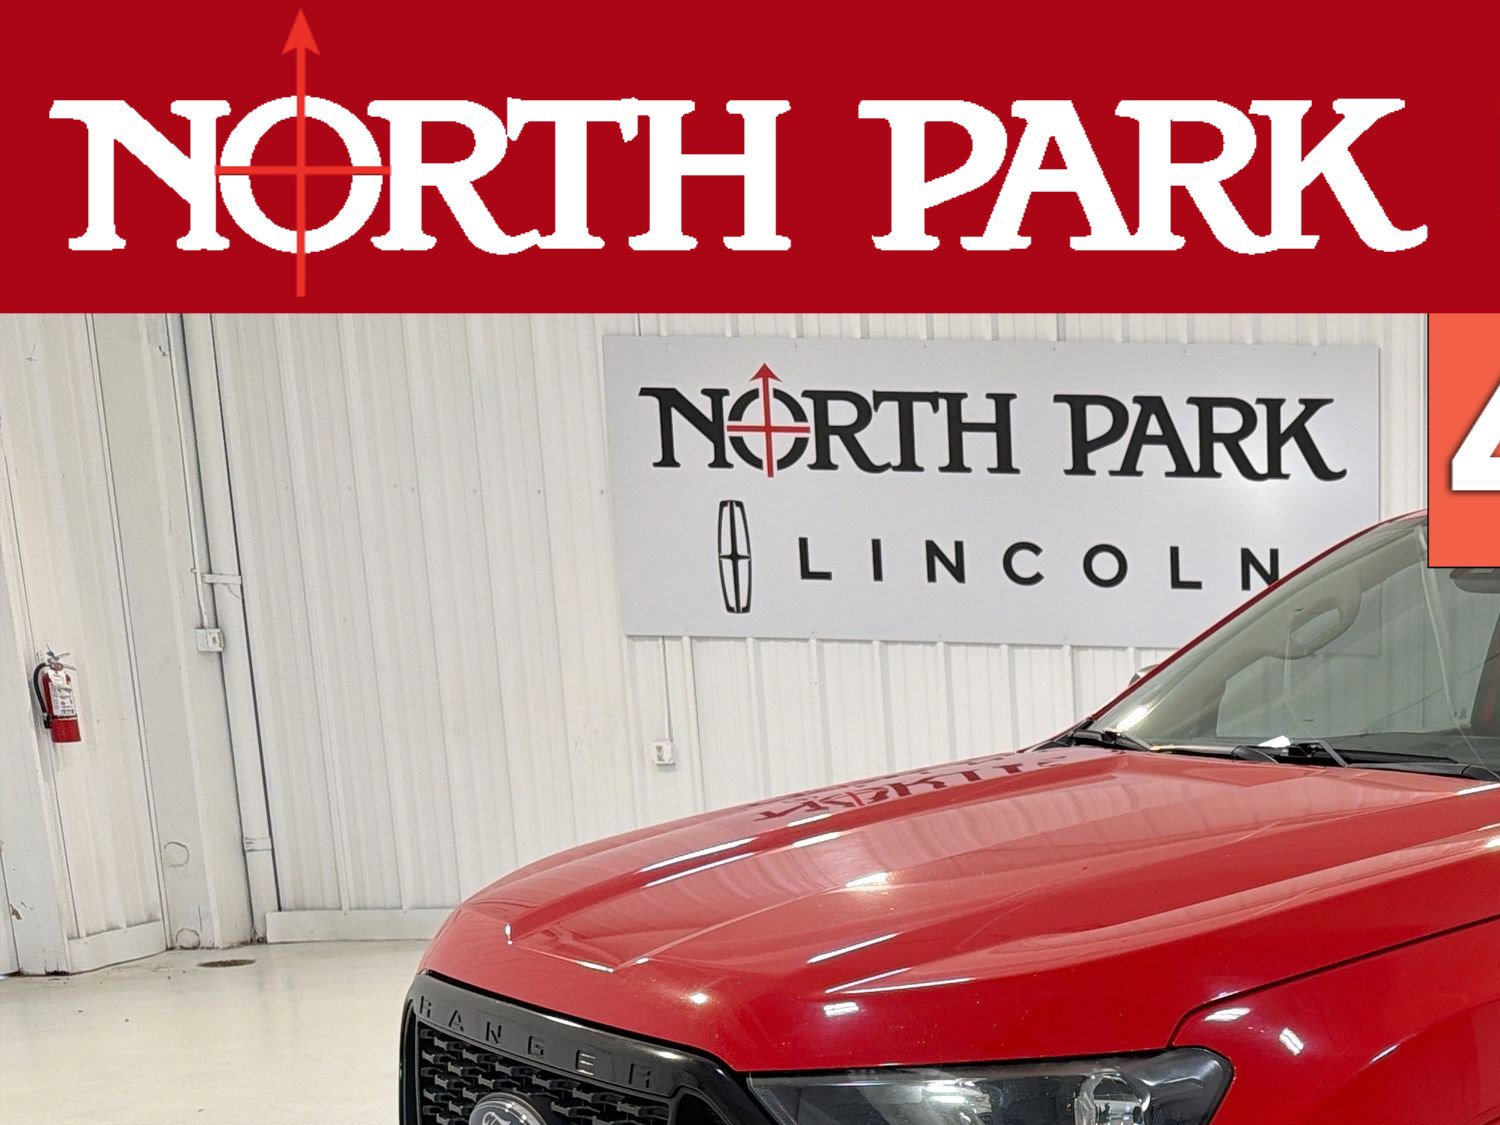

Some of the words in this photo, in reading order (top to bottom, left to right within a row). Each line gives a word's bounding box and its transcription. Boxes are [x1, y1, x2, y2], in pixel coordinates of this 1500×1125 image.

[639, 388, 1020, 474] NORTH
[1054, 394, 1346, 481] PARK
[799, 537, 1279, 591] LINCOLN
[420, 995, 652, 1089] RANGER
